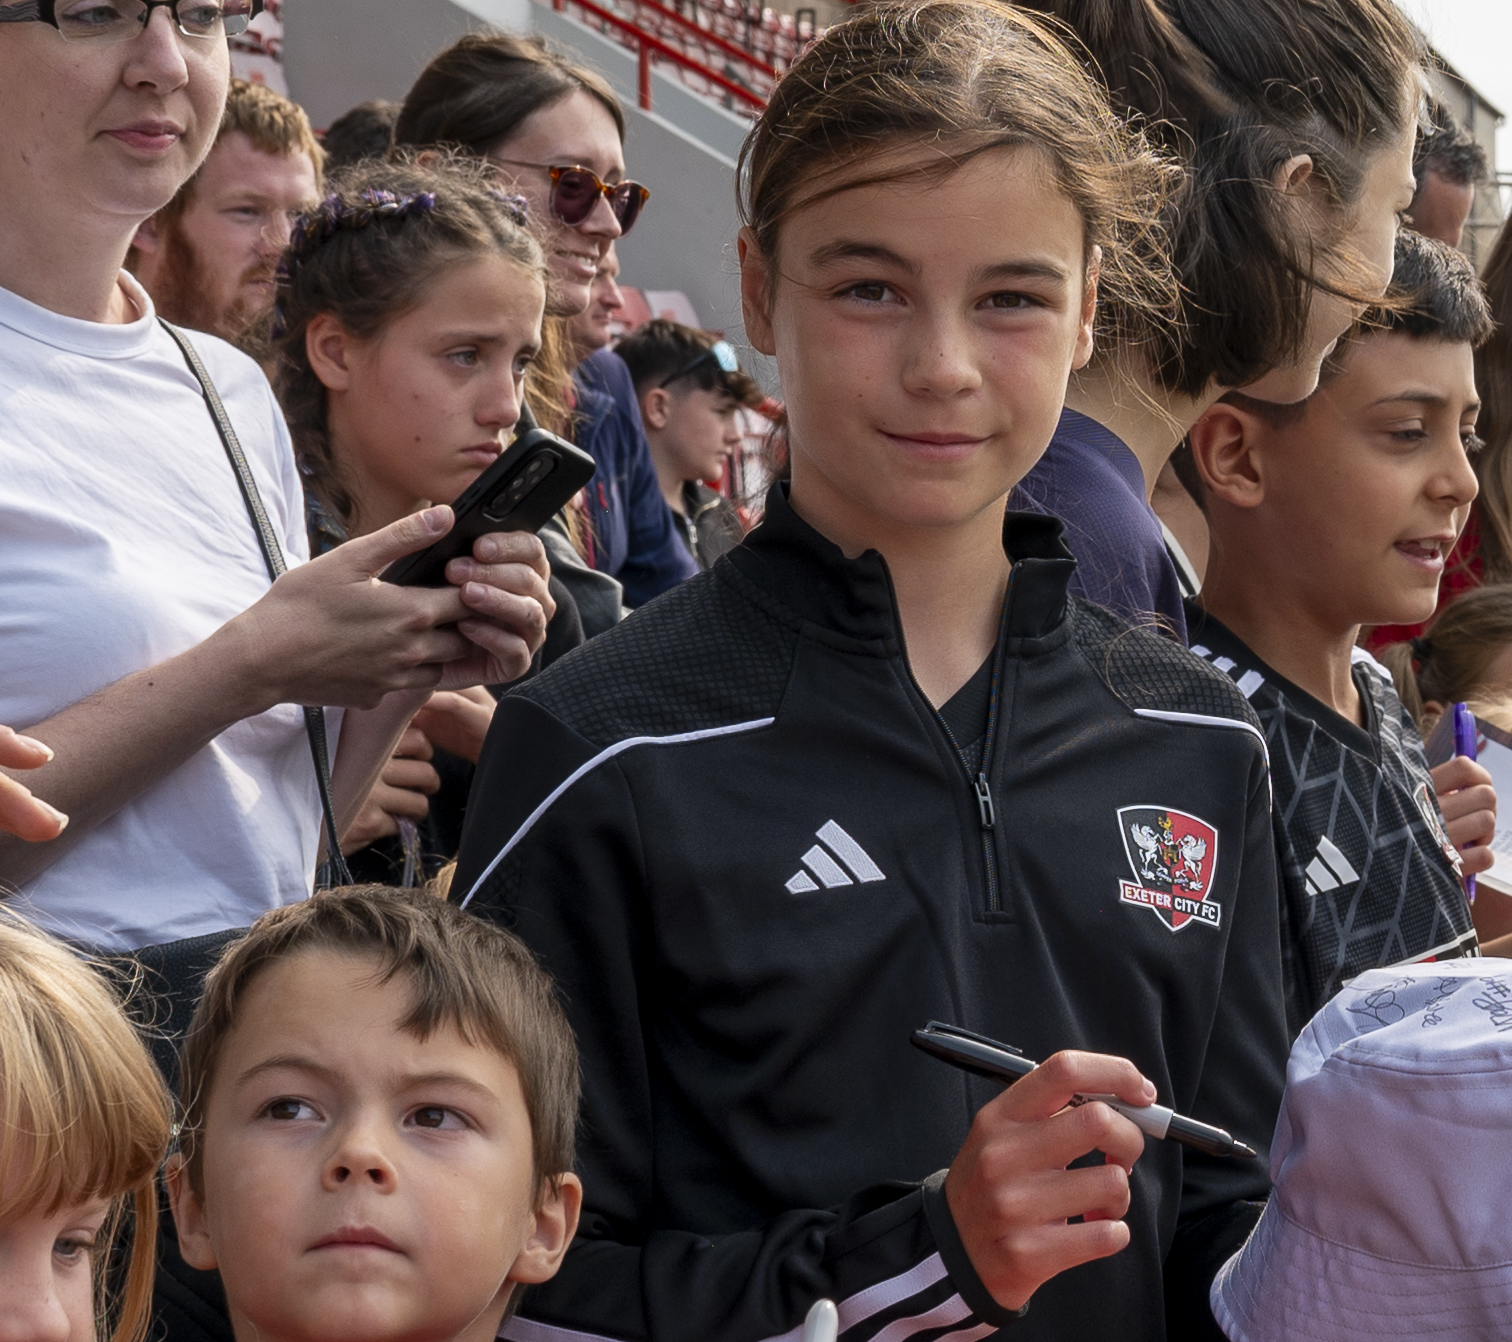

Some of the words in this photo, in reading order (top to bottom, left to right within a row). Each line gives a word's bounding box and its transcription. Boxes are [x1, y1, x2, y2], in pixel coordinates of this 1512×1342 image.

[1123, 885, 1172, 909] EXETER
[1173, 897, 1200, 915] CITY
[1201, 905, 1217, 920] FC
